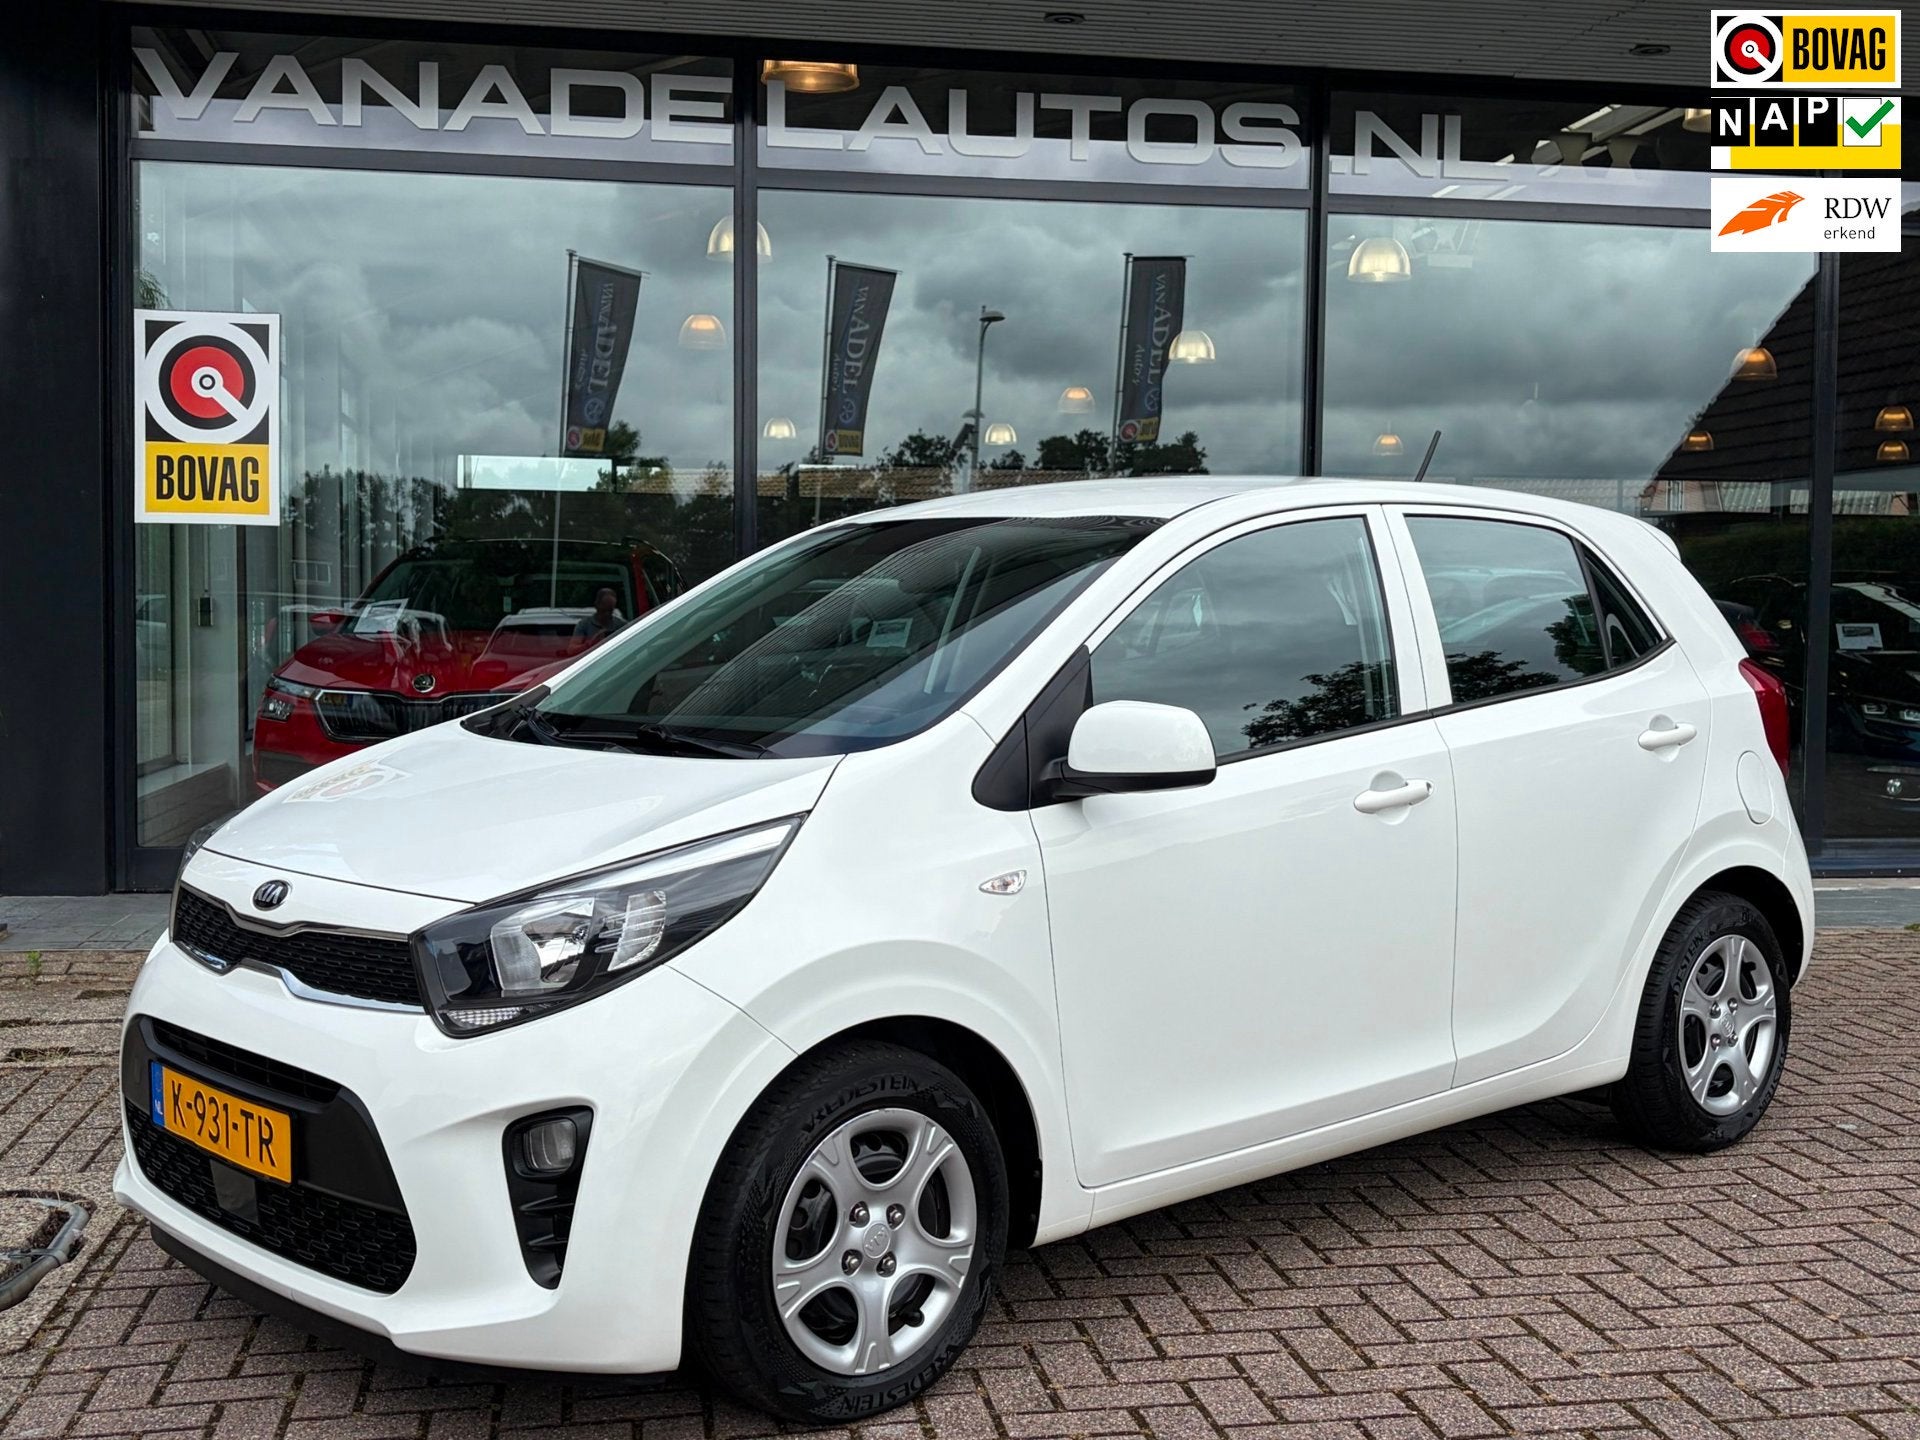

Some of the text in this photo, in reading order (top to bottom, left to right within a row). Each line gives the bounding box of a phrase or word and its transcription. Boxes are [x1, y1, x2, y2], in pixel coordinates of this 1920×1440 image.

[156, 455, 259, 502] BOVAG
[254, 883, 284, 904] KIA
[171, 1080, 277, 1167] K-931-TR
